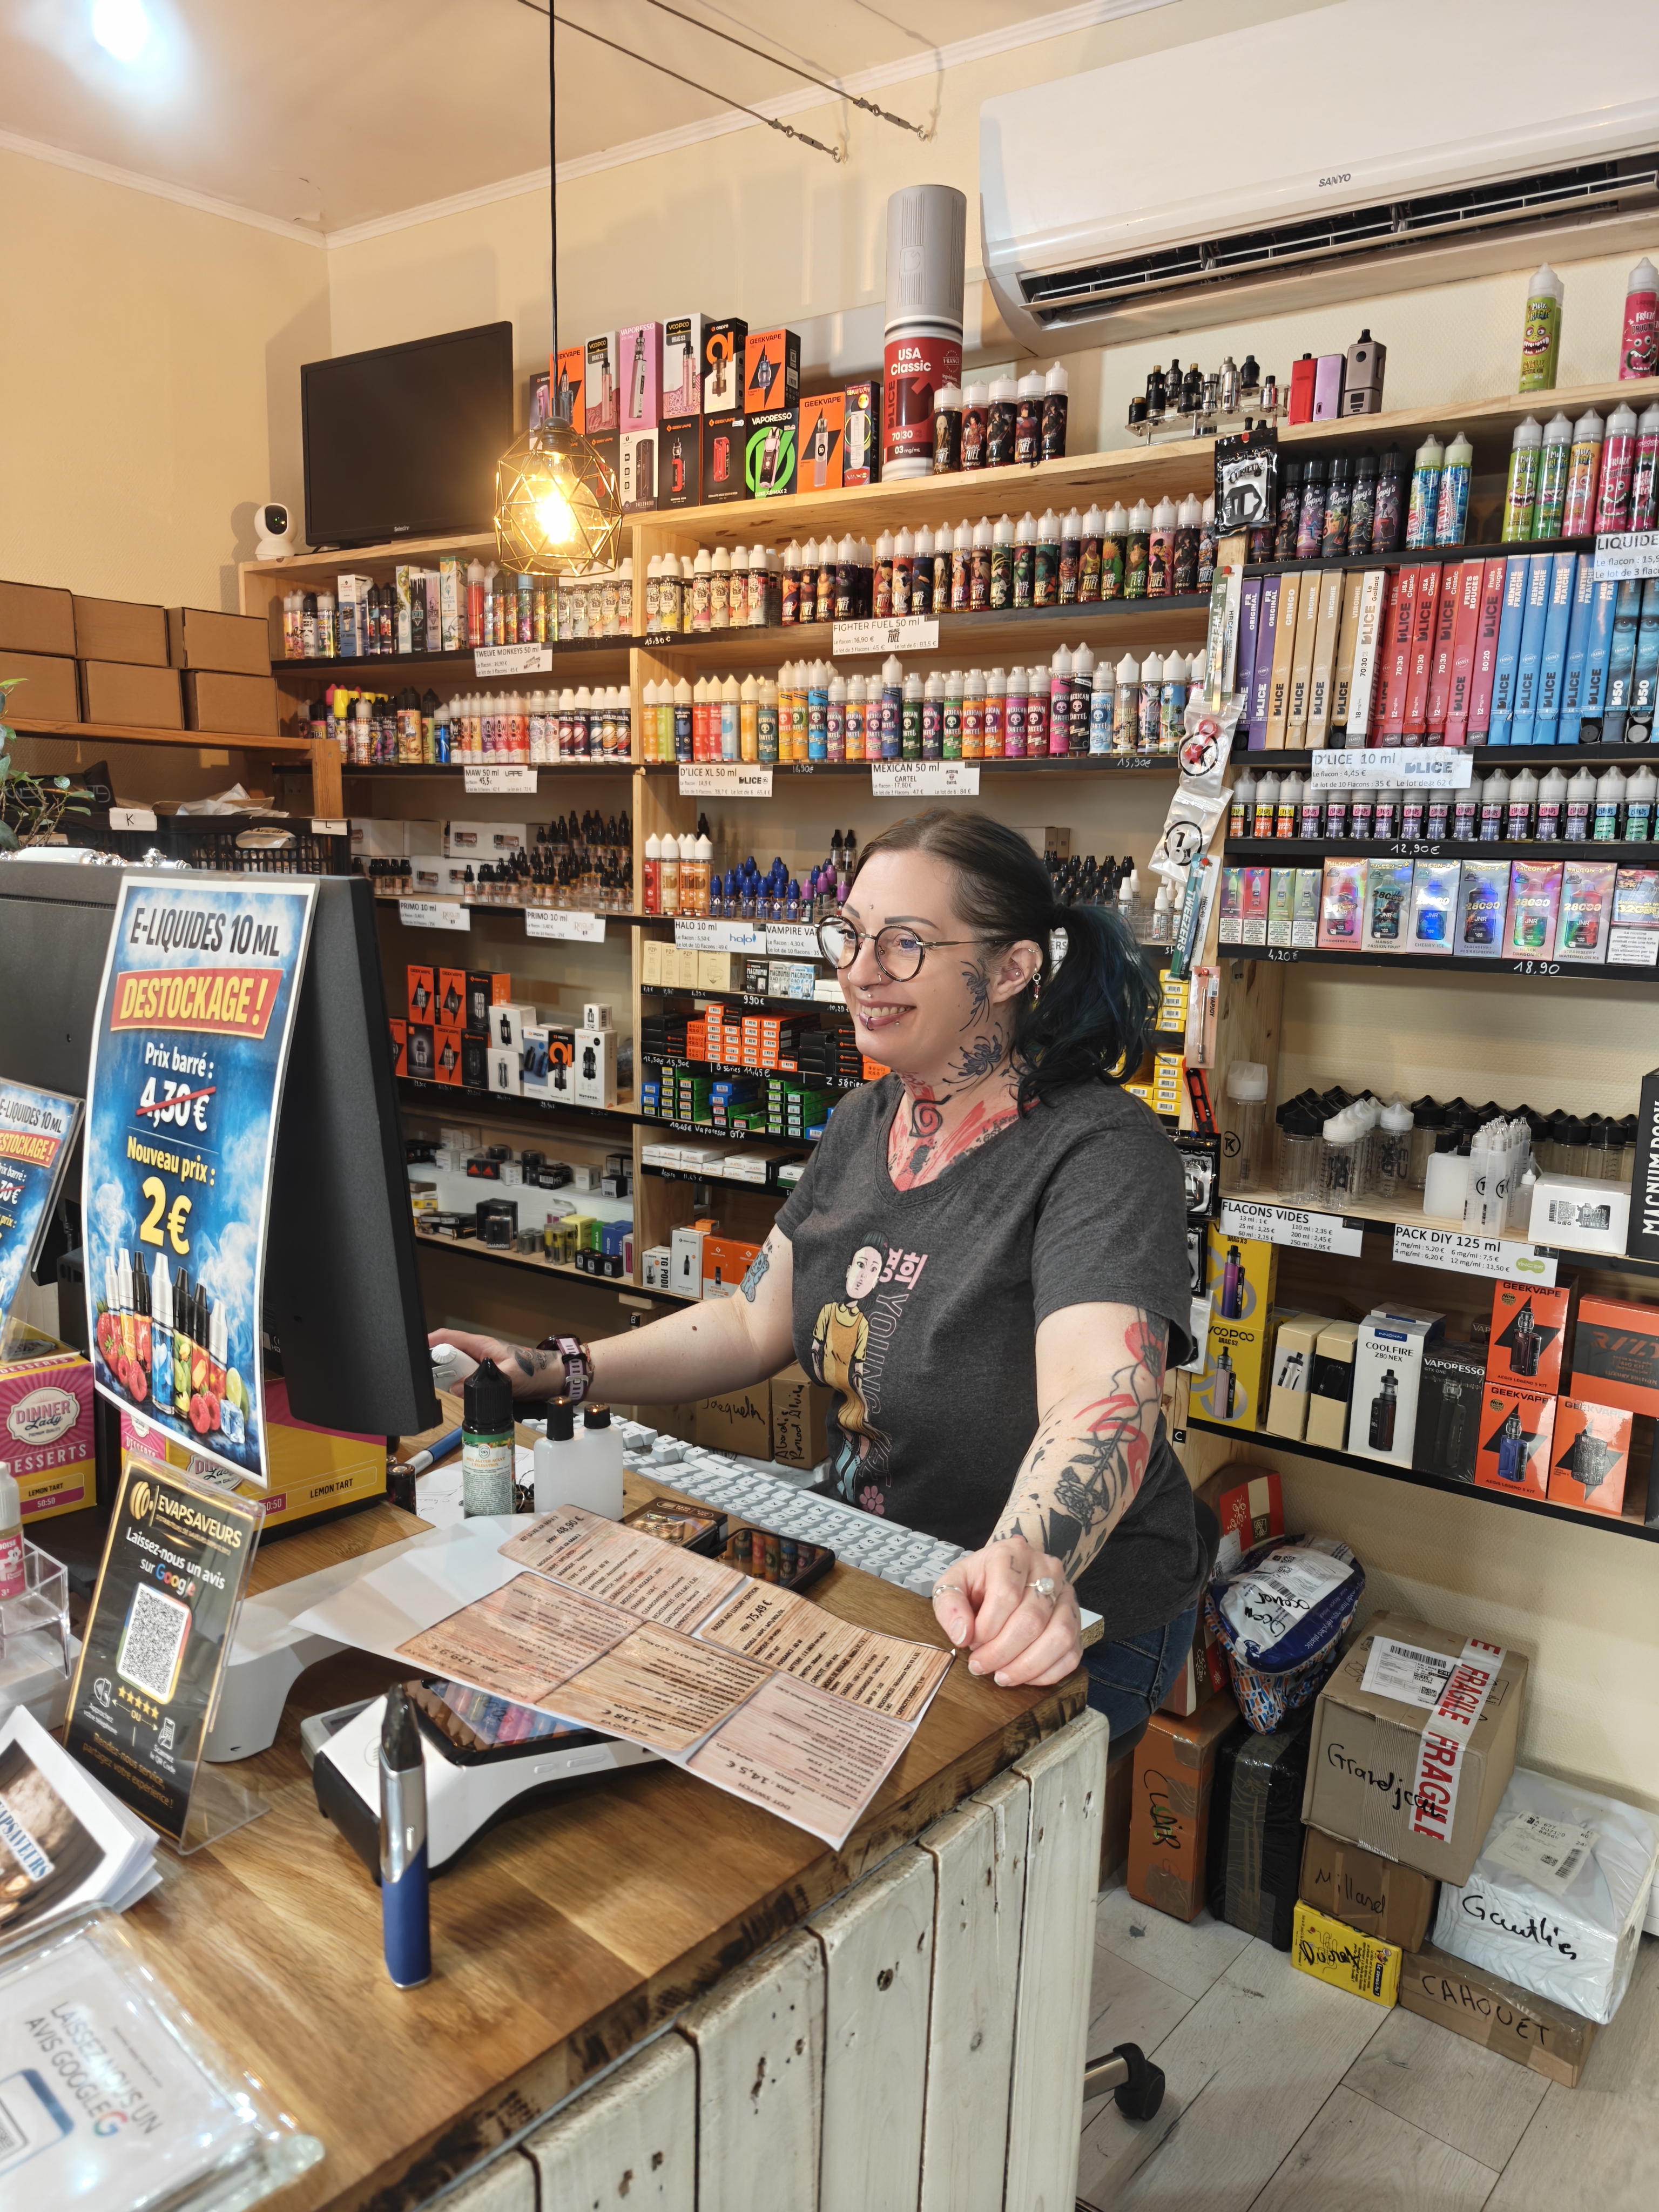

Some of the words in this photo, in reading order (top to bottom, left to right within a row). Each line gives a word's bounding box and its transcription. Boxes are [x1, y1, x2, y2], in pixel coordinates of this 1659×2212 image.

[1318, 173, 1351, 187] SANYO
[621, 323, 655, 335] VAPORESSO
[669, 321, 689, 330] VOOPOO
[589, 340, 606, 349] VOOPOO
[750, 334, 781, 345] GEEKVAPE
[898, 347, 921, 361] USA
[891, 360, 932, 376] Classic
[805, 396, 841, 408] GEEKVAPE
[752, 412, 792, 426] VAPORESSO
[894, 444, 903, 454] 03
[1608, 557, 1634, 567] flacon
[1464, 576, 1473, 605] FRUITS
[1470, 575, 1479, 609] ROUGES
[1507, 571, 1517, 606] MENTHE
[1514, 570, 1523, 608] FRAICHE
[1530, 570, 1540, 605] MENTHE
[1537, 569, 1547, 606] FRAICHE
[1244, 594, 1251, 605] FR
[1265, 590, 1271, 603] FR
[1307, 586, 1316, 619] VIRGINIE
[1328, 585, 1336, 618] VIRGINIE
[1249, 593, 1257, 630] ORIGINAL
[1269, 590, 1278, 627] ORIGINAL
[1285, 589, 1295, 626] GRINGO
[834, 622, 869, 632] FIGHTER
[872, 621, 894, 629] FUEL
[896, 619, 906, 627] 50
[909, 617, 919, 626] ml
[497, 648, 523, 656] MONKEYS
[1117, 758, 1151, 767] 15,90€
[1361, 753, 1375, 764] 10
[1380, 753, 1395, 764] ml
[705, 768, 713, 777] XL
[716, 768, 725, 777] 50
[728, 768, 737, 777] ml
[874, 764, 912, 772] MEXICAN
[915, 763, 926, 772] 50
[929, 763, 939, 772] ml
[127, 813, 134, 826] K
[1391, 844, 1440, 855] 12,90€
[400, 902, 420, 911] PRIMO
[527, 912, 549, 920] PRIMO
[1177, 891, 1193, 953] TWEEZERS
[130, 907, 226, 953] E-LIQUIDES
[230, 914, 254, 955] 10
[252, 925, 280, 957] ML
[676, 921, 695, 929] HALO
[767, 925, 802, 935] VAMPIRE
[730, 934, 752, 945] halo
[1269, 949, 1291, 961] 4,20
[1513, 961, 1560, 974] 18,90
[119, 976, 254, 1023] DESTOCKAGE
[145, 1042, 170, 1068] Prix
[172, 1046, 207, 1077] barré
[694, 1124, 726, 1137] Vaporesso
[730, 1130, 745, 1139] GTX
[127, 1135, 179, 1175] Nouveau
[181, 1155, 208, 1185] prix
[140, 1176, 192, 1255] 2€
[1222, 1201, 1272, 1218] FLACONS
[1276, 1210, 1309, 1224] VIDES
[1396, 1227, 1427, 1240] PACK
[1431, 1232, 1452, 1244] DIY
[1456, 1237, 1480, 1249] 125
[1485, 1242, 1500, 1252] ml
[1460, 1259, 1481, 1267] mg/ml
[1486, 1264, 1504, 1272] 11,50
[1503, 1282, 1561, 1298] GEEKVAPE
[1208, 1326, 1254, 1343] VOOPOO
[1366, 1341, 1413, 1358] COOLFIRE
[1424, 1358, 1485, 1376] VAPORESSO
[1492, 1387, 1549, 1405] GEEKVAPE
[16, 1400, 70, 1424] DINNER
[25, 1415, 63, 1430] Lady
[29, 1487, 48, 1496] LEMON
[50, 1483, 63, 1491] TART
[310, 1480, 334, 1499] LEMON
[335, 1478, 353, 1492] TART
[37, 1498, 55, 1508] 50:50
[158, 1495, 242, 1548] EVAPSAVEURS
[556, 1519, 578, 1535] 48,90
[126, 1527, 185, 1570] Laissez-nous
[187, 1565, 200, 1577] un
[201, 1570, 226, 1590] avis
[140, 1558, 155, 1574] sur
[156, 1562, 195, 1597] Google
[711, 1617, 724, 1631] RAZOR
[732, 1600, 745, 1615] LUXURY
[744, 1586, 760, 1603] EDITION
[746, 1604, 767, 1622] 75,49
[1438, 1663, 1491, 1725] FRAGILE
[739, 1766, 770, 1784] 14,5
[24, 2017, 63, 2053] AVIS
[131, 2103, 163, 2134] UN
